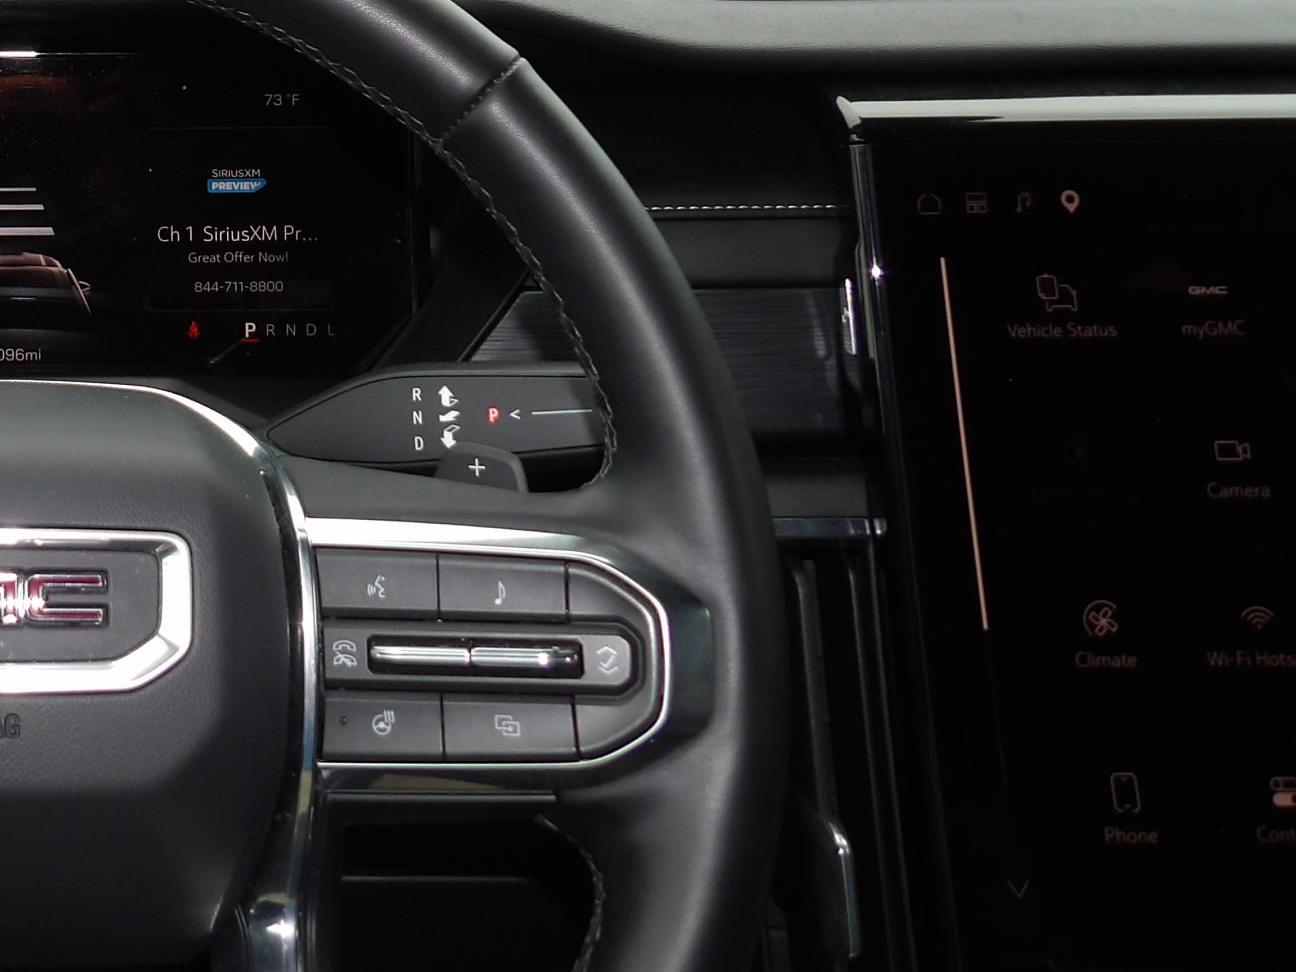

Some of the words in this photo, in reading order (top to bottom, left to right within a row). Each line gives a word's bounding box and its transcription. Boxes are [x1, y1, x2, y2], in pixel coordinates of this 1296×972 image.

[264, 94, 283, 107] 73
[211, 168, 261, 177] SIRIUSXM
[212, 181, 261, 191] PREVIEW
[157, 226, 180, 242] Ch
[186, 226, 193, 241] 1
[203, 225, 278, 242] SiriusXM
[188, 252, 221, 264] Great
[224, 251, 255, 264] Offer
[258, 252, 289, 263] Now!
[194, 280, 284, 292] 844-711-8800
[1188, 286, 1228, 295] GMC
[245, 322, 256, 338] P
[266, 324, 275, 335] R
[286, 324, 296, 336] N
[306, 324, 317, 336] D
[328, 324, 336, 336] L
[1007, 323, 1062, 338] Vehicle
[1066, 323, 1118, 338] Status
[1182, 321, 1246, 339] myGMC
[412, 388, 421, 401] R
[412, 411, 422, 425] N
[488, 407, 499, 423] P
[414, 436, 424, 451] D
[1207, 482, 1271, 499] Camera
[1075, 651, 1138, 668] Climate
[1207, 651, 1251, 667] Wi-Fi
[1104, 826, 1159, 844] Phone
